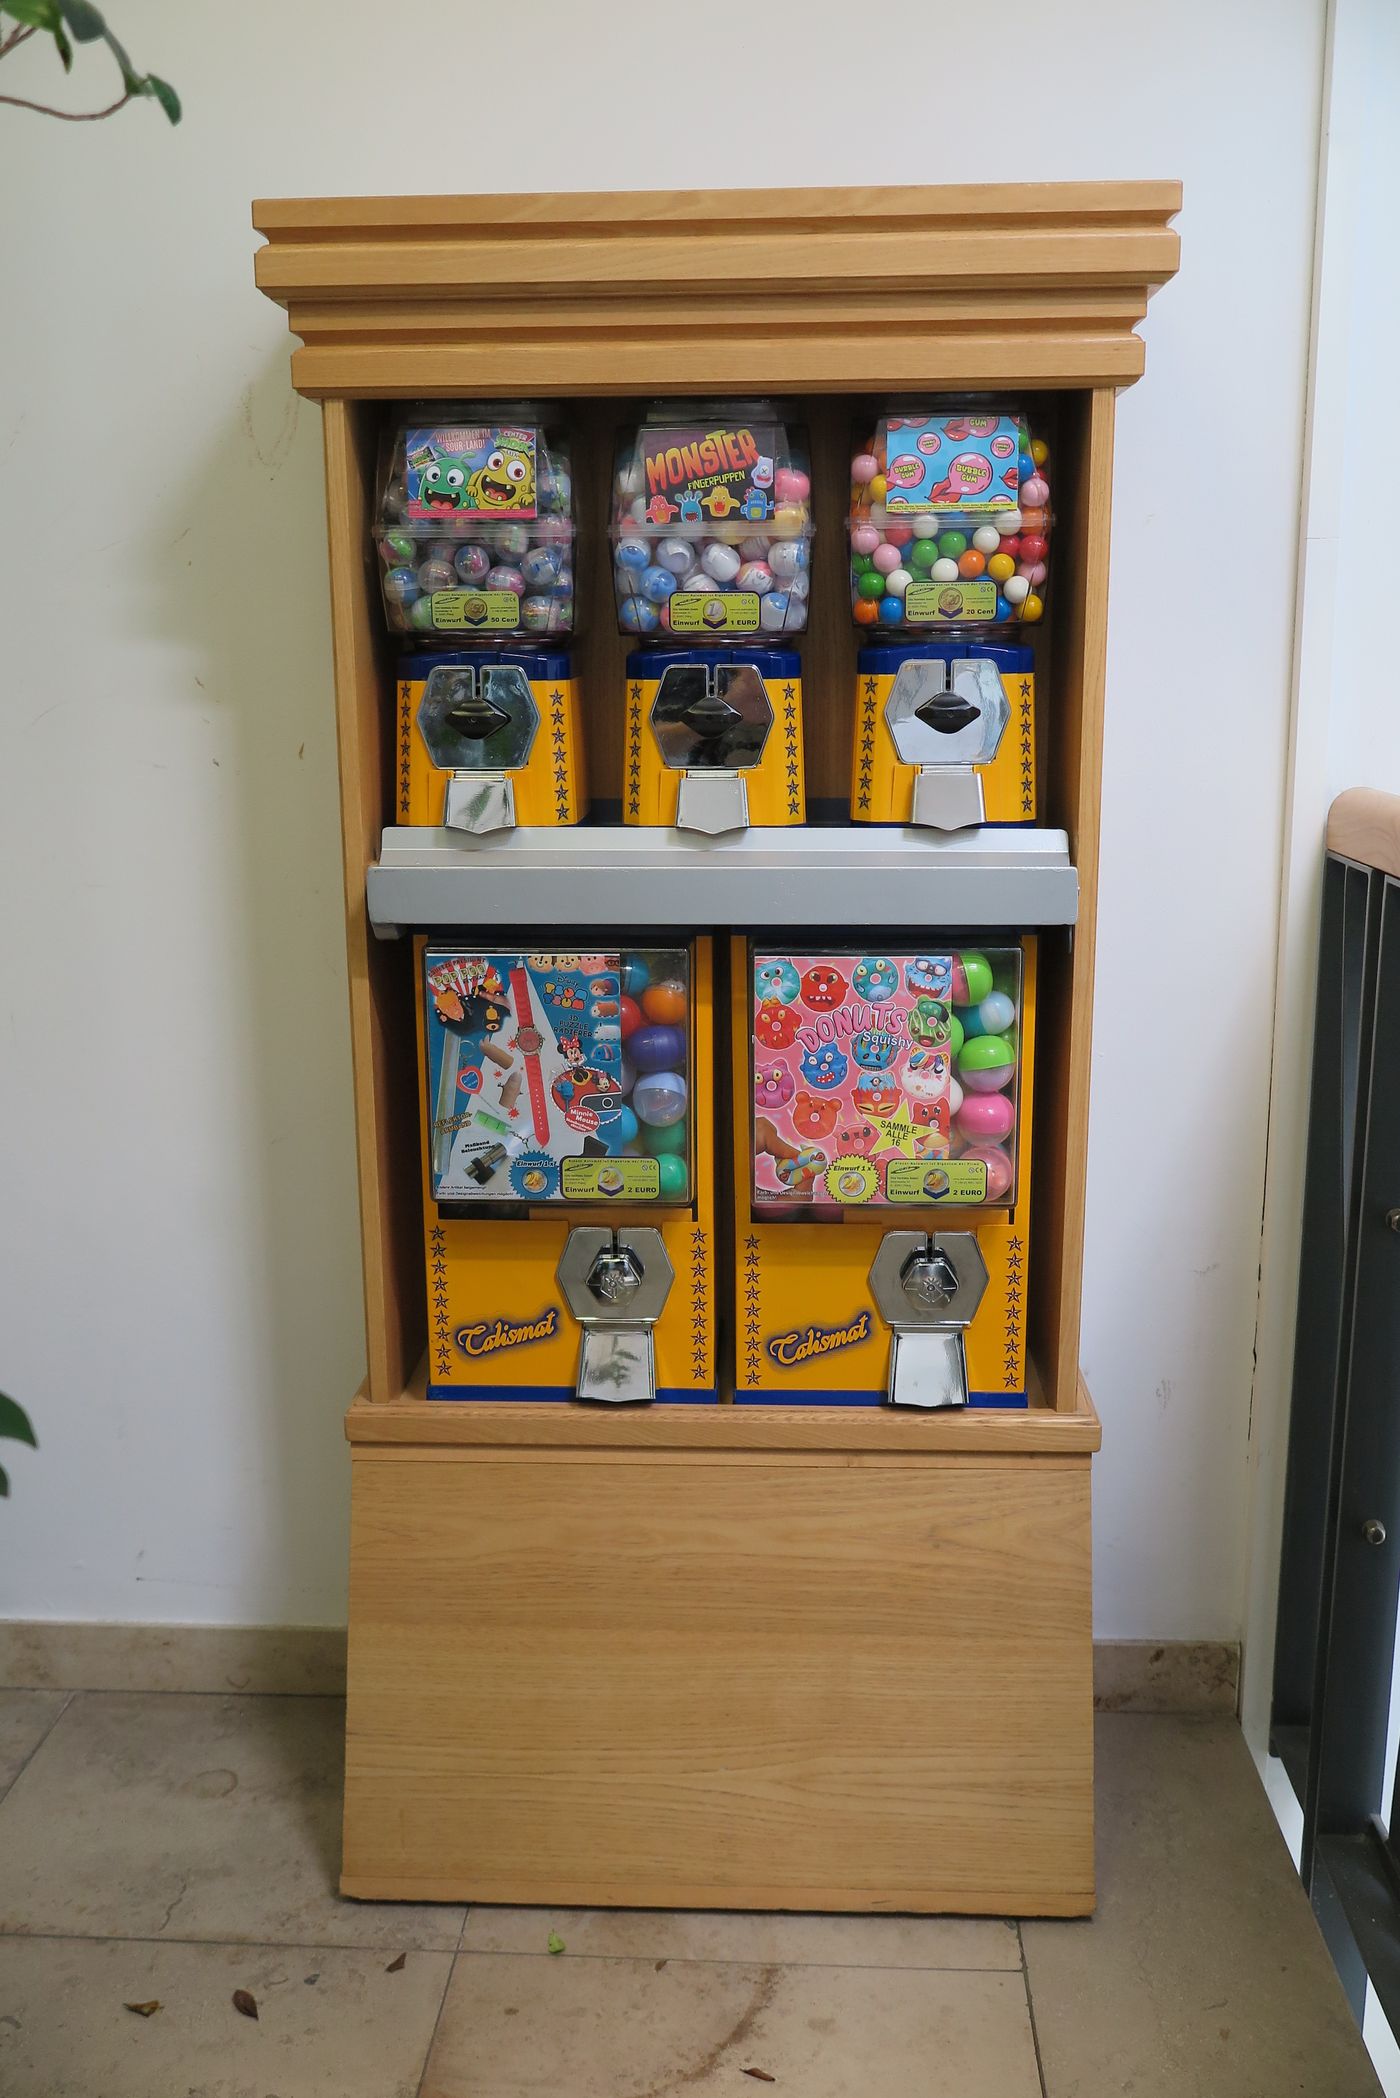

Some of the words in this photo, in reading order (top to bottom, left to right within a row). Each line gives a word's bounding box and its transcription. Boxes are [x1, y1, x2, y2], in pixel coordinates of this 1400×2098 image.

[969, 418, 988, 427] GUM
[435, 430, 481, 443] WILLKOMMEN
[503, 430, 528, 441] CENTER
[445, 439, 486, 452] SOUR-LAND!
[646, 429, 760, 495] MONSTER
[894, 462, 920, 474] BUBBLE
[900, 471, 915, 479] GUM
[955, 463, 988, 477] BUBBLE
[687, 470, 746, 490] FINGERPUPPEN
[961, 474, 978, 484] GUM
[433, 971, 458, 986] POP
[569, 1014, 579, 1022] 3D
[559, 1020, 589, 1030] PUZZLE
[795, 1003, 908, 1053] DONUTS
[553, 1026, 593, 1038] RADIERER
[862, 1031, 913, 1050] Squishy
[570, 1109, 594, 1117] Minnie
[575, 1115, 599, 1126] Mouse
[880, 1120, 918, 1135] SAMMLE
[885, 1130, 909, 1141] ALLE
[464, 1140, 490, 1148] Maßband
[892, 1138, 901, 1147] 16
[457, 1311, 556, 1355] Calismat
[769, 1314, 868, 1365] Calismat
